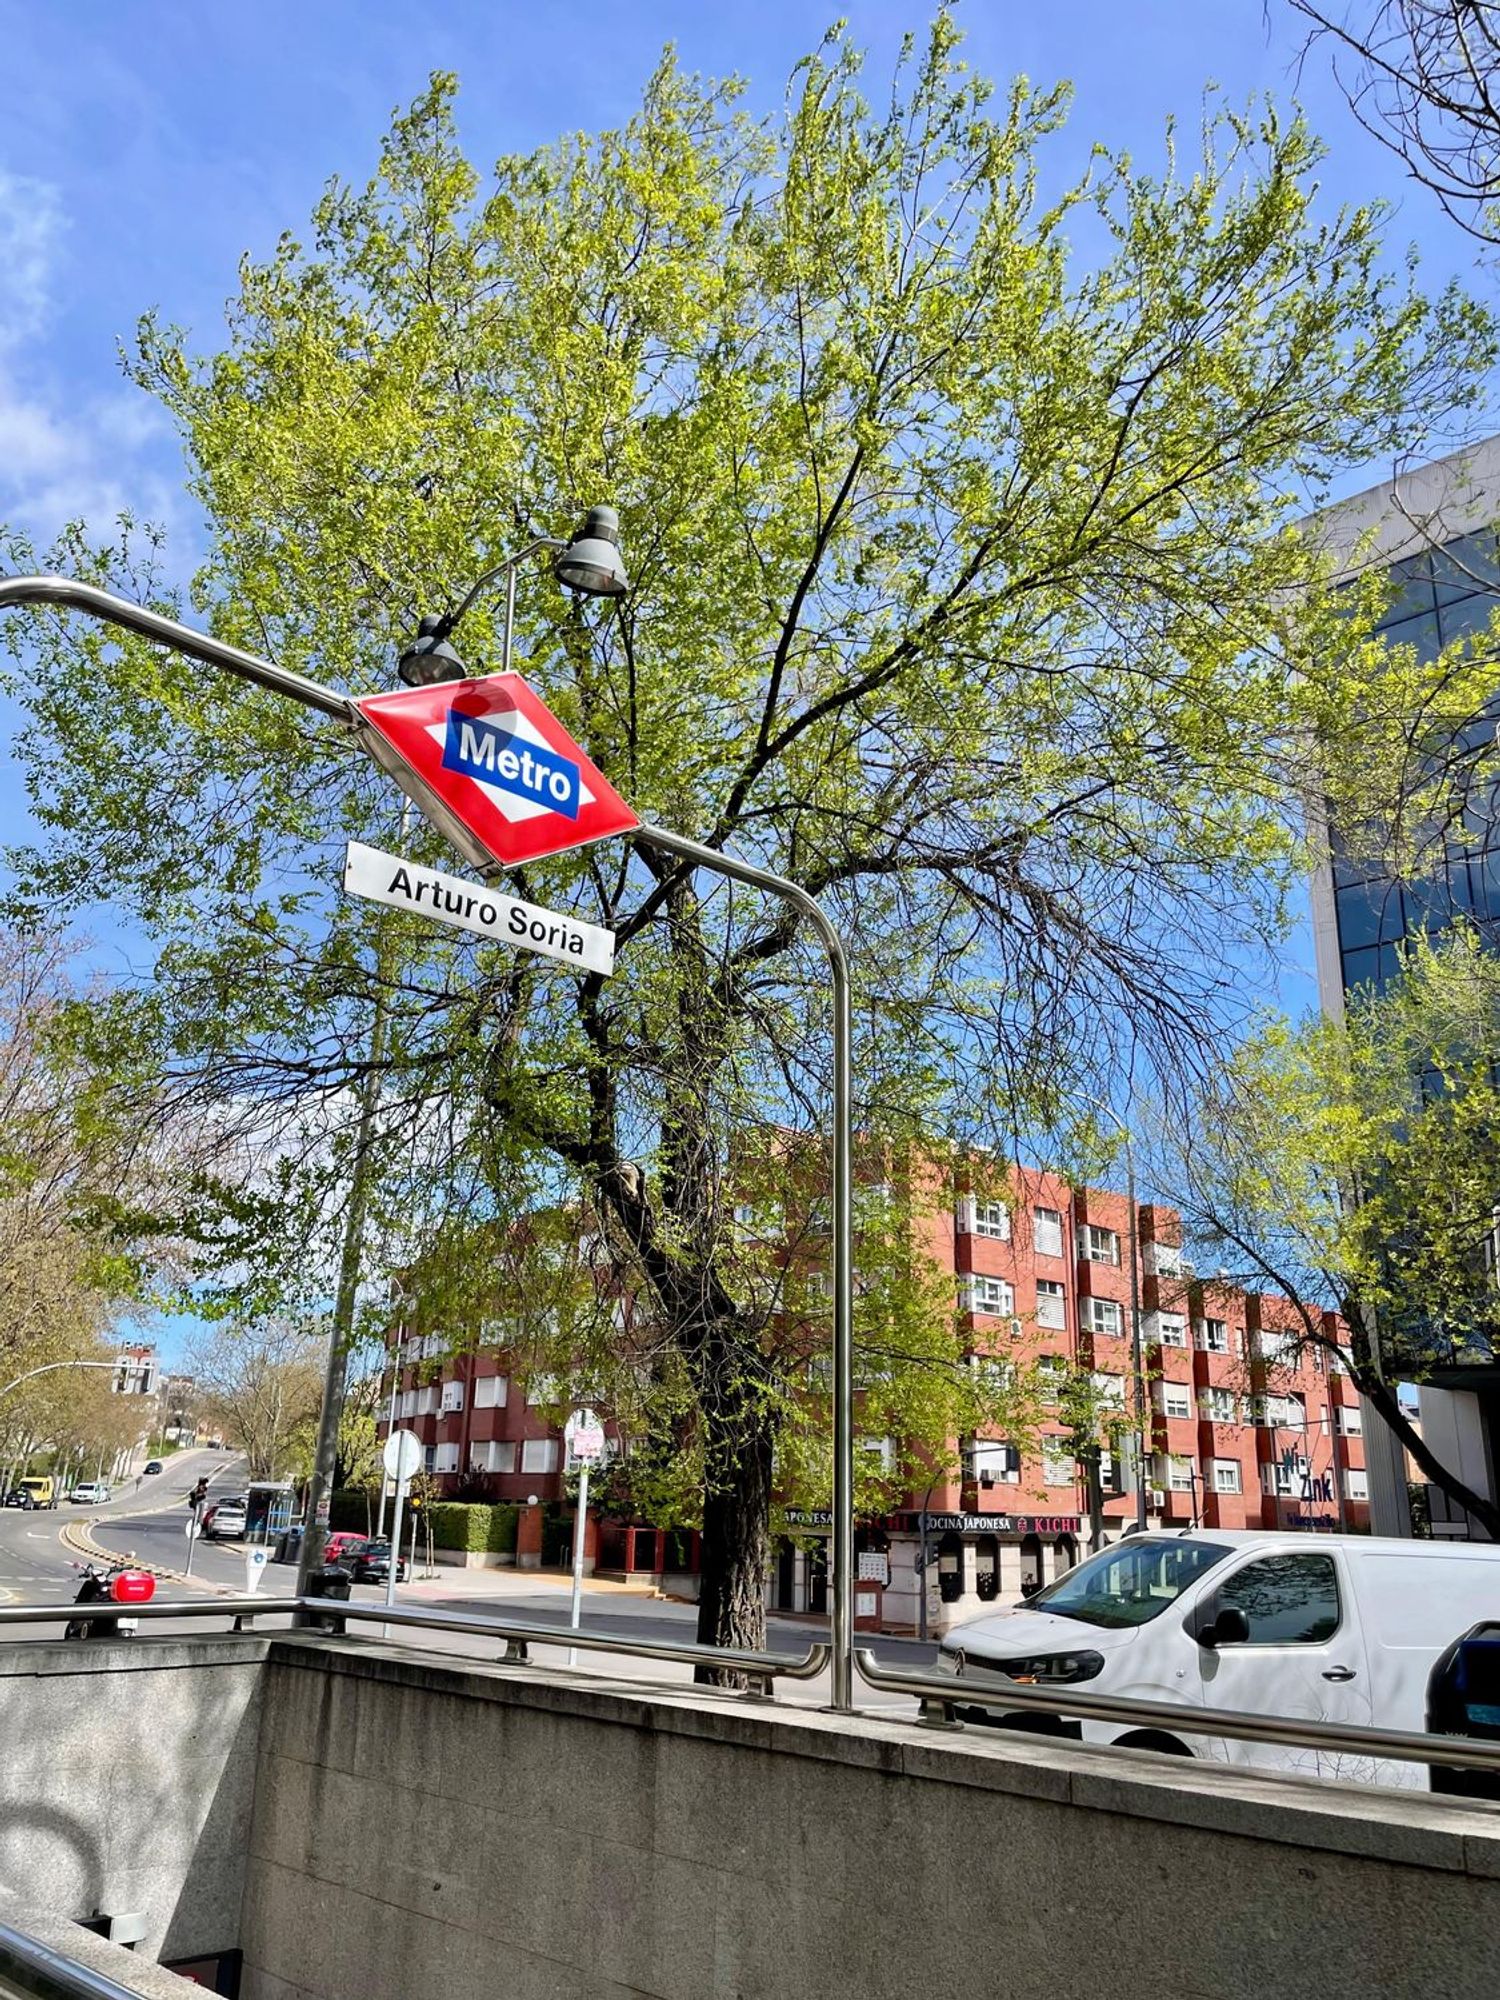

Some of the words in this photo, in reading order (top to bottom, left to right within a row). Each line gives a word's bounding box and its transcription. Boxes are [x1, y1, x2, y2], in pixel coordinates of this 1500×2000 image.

[459, 722, 571, 802] Metro
[387, 867, 498, 926] Arturo
[508, 906, 584, 956] Soria
[780, 1511, 832, 1524] APONESA
[927, 1517, 962, 1529] OCINA
[964, 1517, 1011, 1531] JAPONESA
[1034, 1518, 1079, 1533] KICHI
